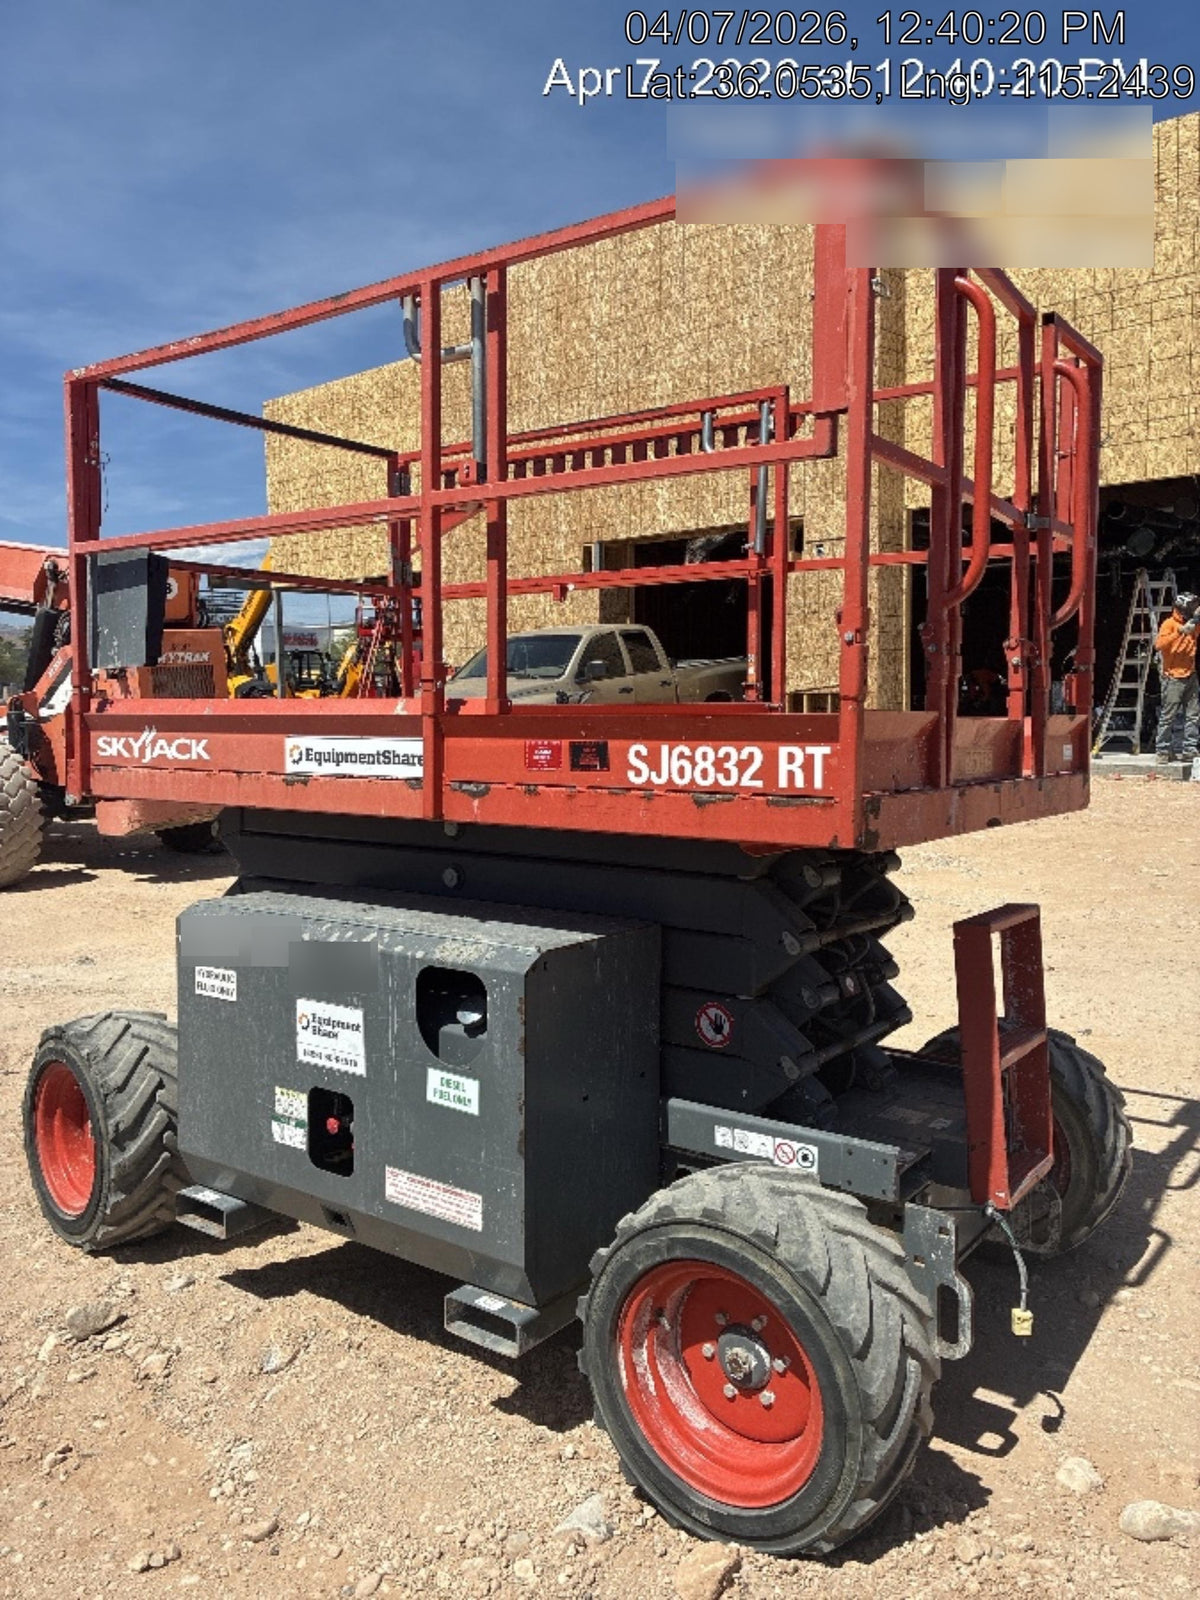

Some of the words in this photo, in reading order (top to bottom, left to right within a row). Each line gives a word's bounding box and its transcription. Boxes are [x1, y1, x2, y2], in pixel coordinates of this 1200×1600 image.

[157, 651, 210, 664] KYTRAK
[97, 725, 210, 764] SKYJACK
[627, 743, 764, 787] SJ6832
[778, 746, 831, 790] RT
